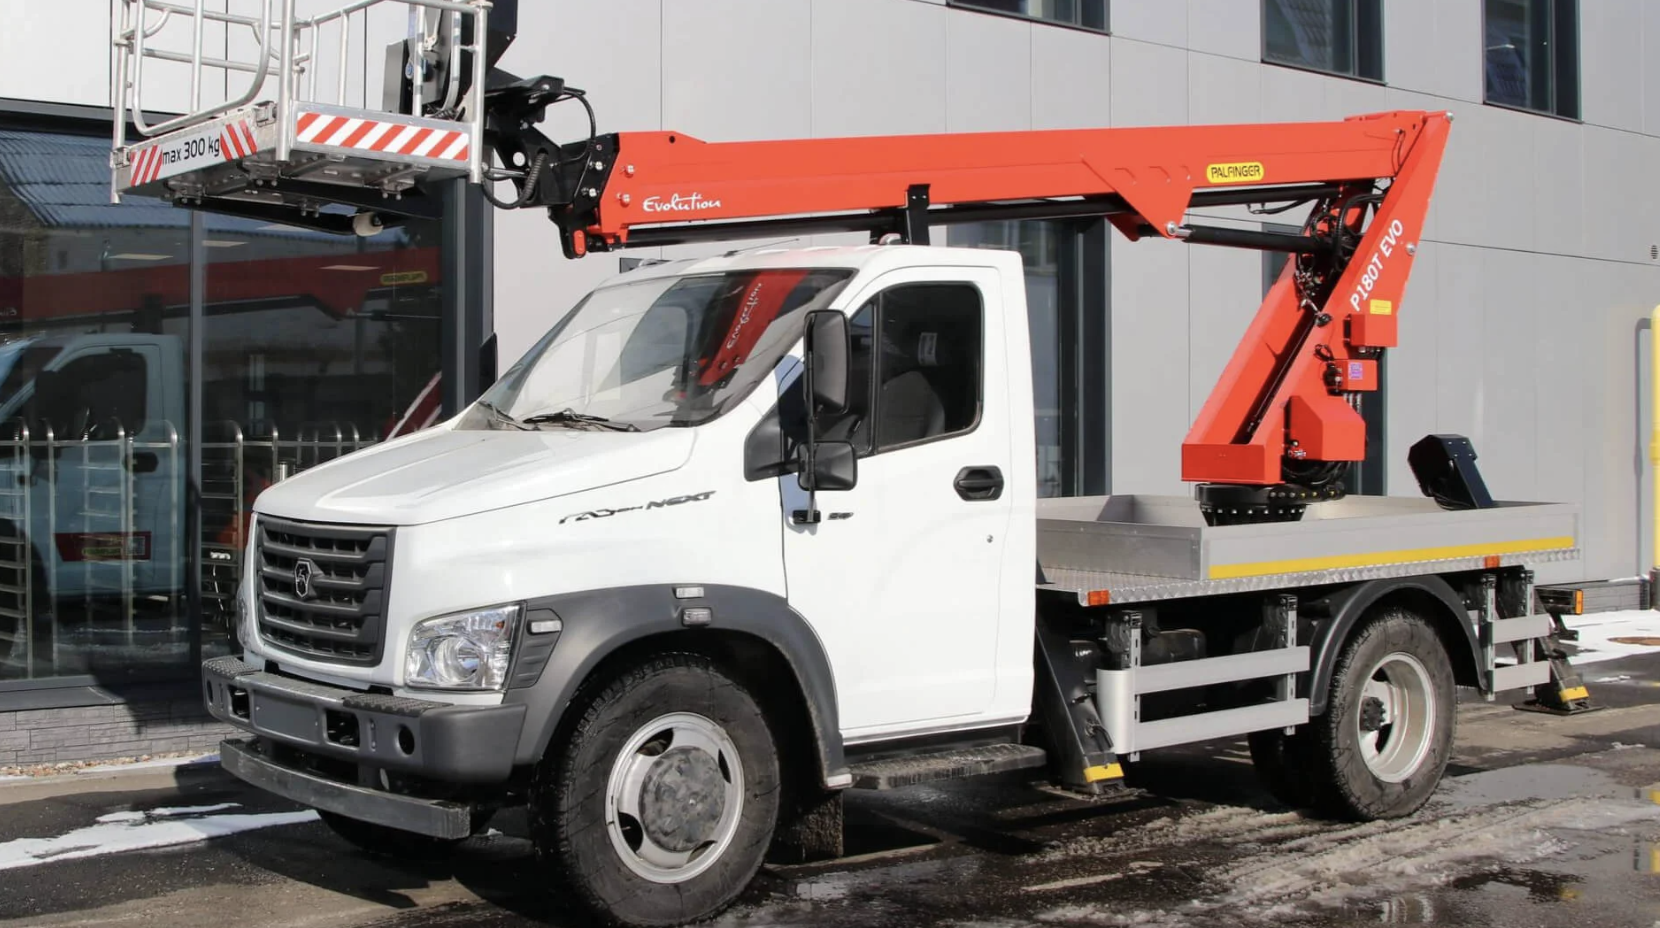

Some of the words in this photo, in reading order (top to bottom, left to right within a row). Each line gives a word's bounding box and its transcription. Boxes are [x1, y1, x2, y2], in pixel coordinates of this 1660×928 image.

[162, 147, 181, 165] max
[183, 138, 206, 160] 300
[208, 136, 221, 157] kg
[1210, 164, 1261, 179] PALFINGER
[642, 192, 721, 212] Evolution
[1350, 252, 1383, 312] P180T
[1380, 219, 1403, 258] EVO
[645, 490, 716, 510] NEXT
